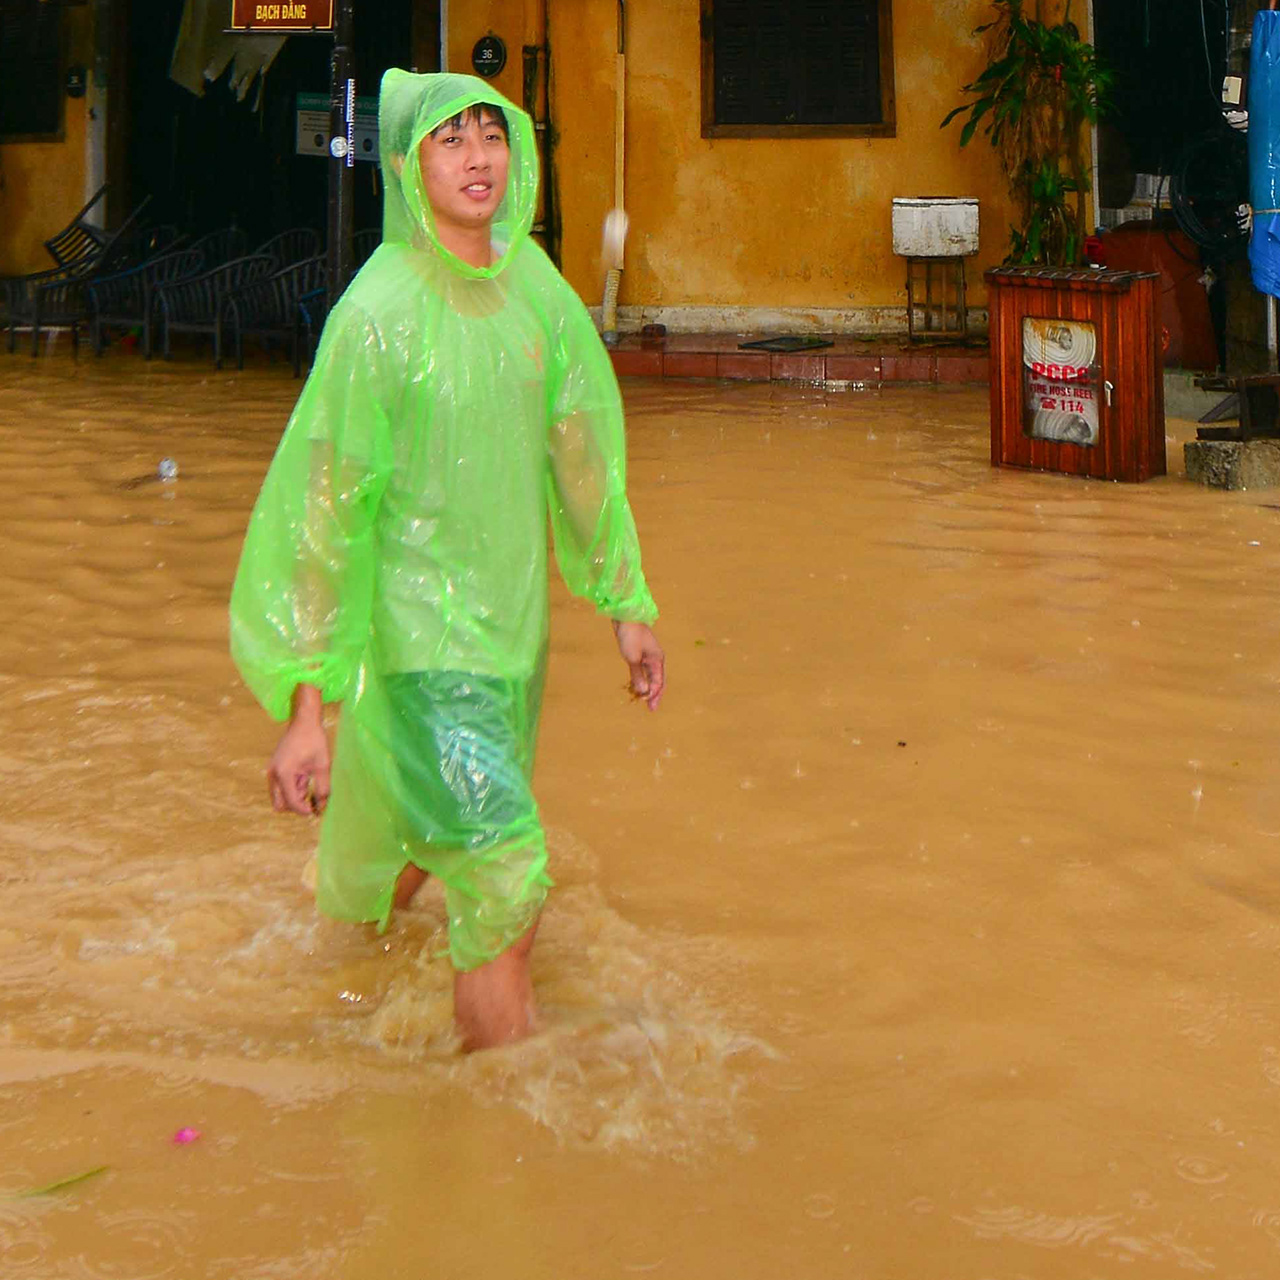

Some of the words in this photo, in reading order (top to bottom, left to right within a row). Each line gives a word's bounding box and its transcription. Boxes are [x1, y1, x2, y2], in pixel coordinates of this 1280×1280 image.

[256, 4, 280, 22] BẠCH
[481, 48, 493, 60] 36
[1073, 388, 1093, 400] REEL
[1061, 399, 1084, 414] 114
